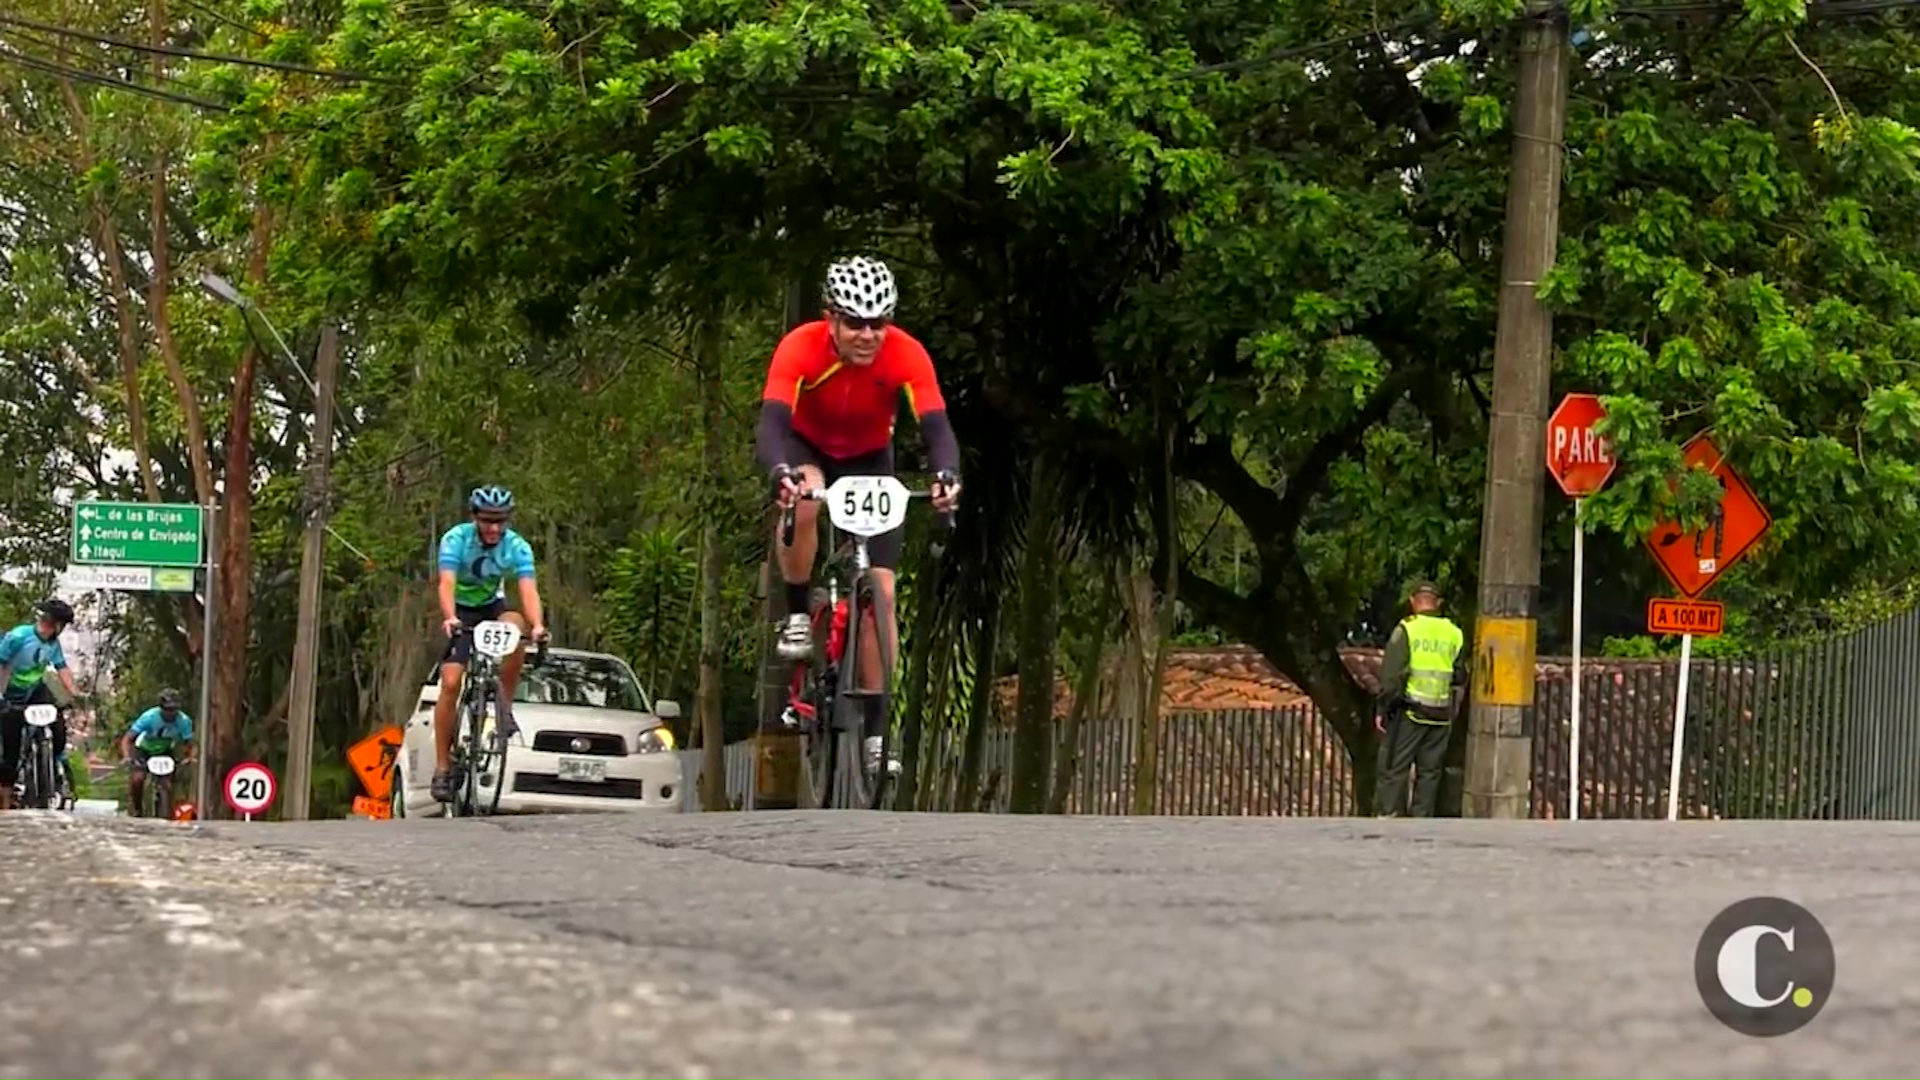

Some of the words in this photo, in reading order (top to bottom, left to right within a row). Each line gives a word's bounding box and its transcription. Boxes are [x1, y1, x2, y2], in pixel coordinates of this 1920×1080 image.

[844, 490, 891, 516] 540
[108, 508, 122, 520] de
[126, 509, 143, 522] las
[147, 509, 183, 525] Brujas
[94, 526, 128, 540] Centro
[131, 528, 144, 540] de
[149, 528, 197, 545] Envigado
[1658, 607, 1668, 624] A
[1673, 608, 1696, 625] 100
[1698, 609, 1716, 627] MT
[483, 629, 512, 647] 657
[235, 778, 266, 800] 20
